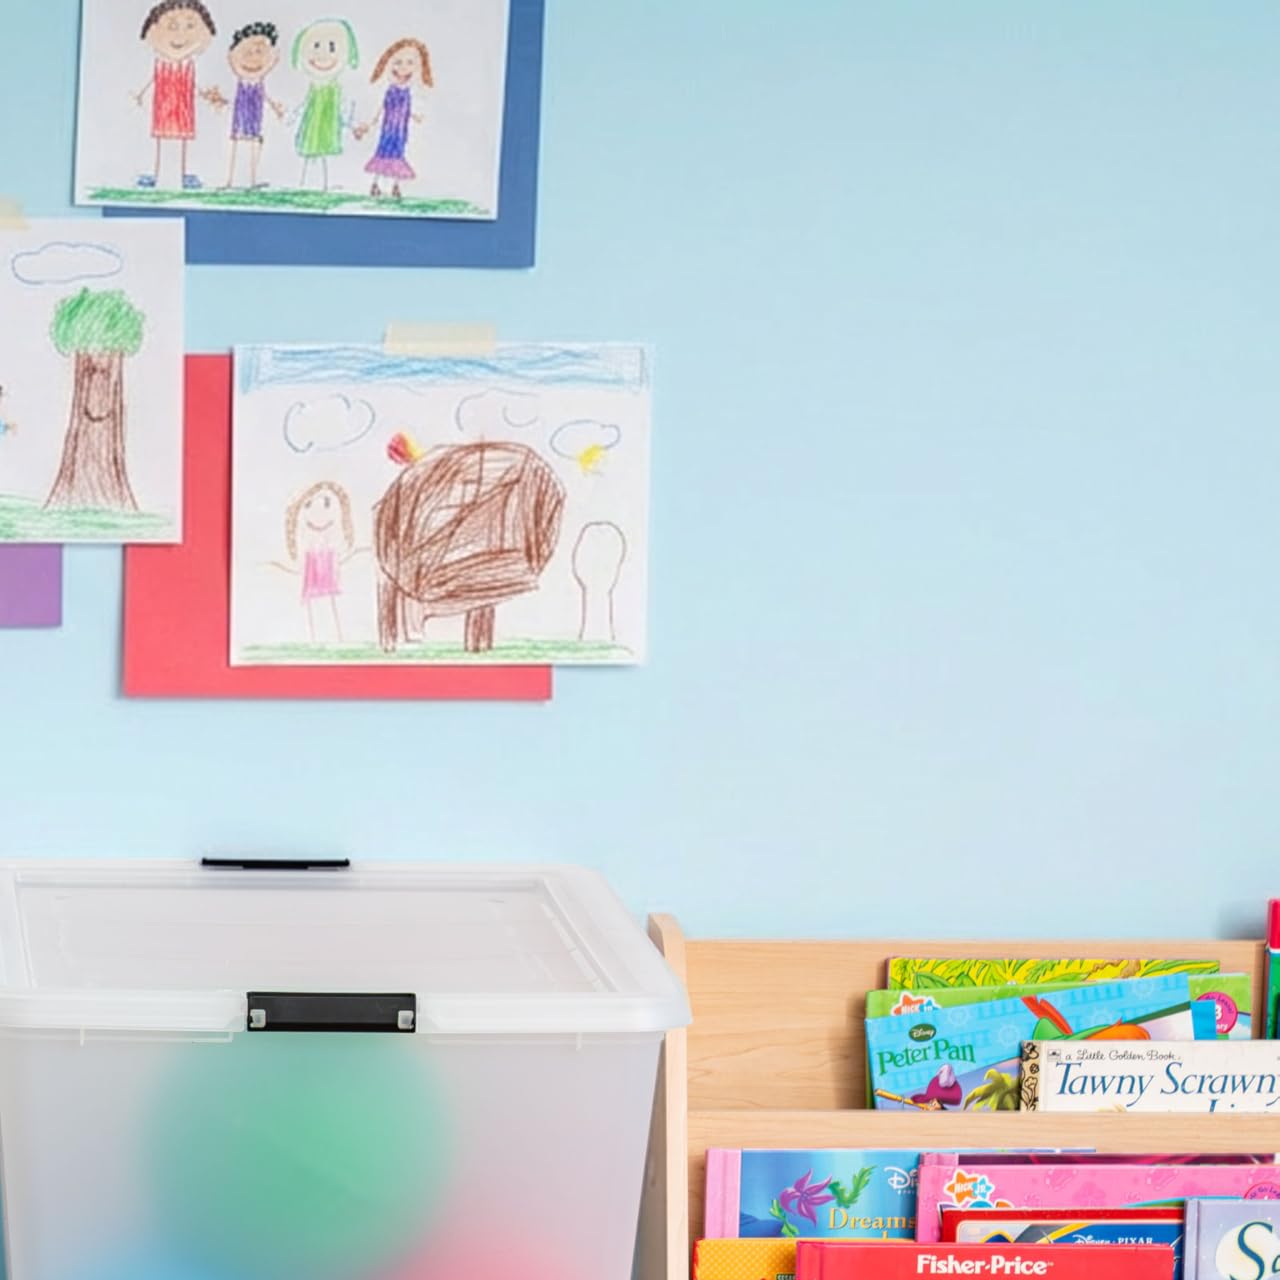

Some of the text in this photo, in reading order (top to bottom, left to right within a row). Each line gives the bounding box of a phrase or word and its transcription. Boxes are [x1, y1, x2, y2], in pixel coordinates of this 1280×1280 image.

[876, 1038, 977, 1076] Peter Pan
[1076, 1049, 1105, 1061] Little
[1108, 1049, 1146, 1061] Golden
[1056, 1061, 1154, 1108] Tawny
[828, 1207, 917, 1230] Dreams
[917, 1253, 1049, 1276] Fisher-Price
